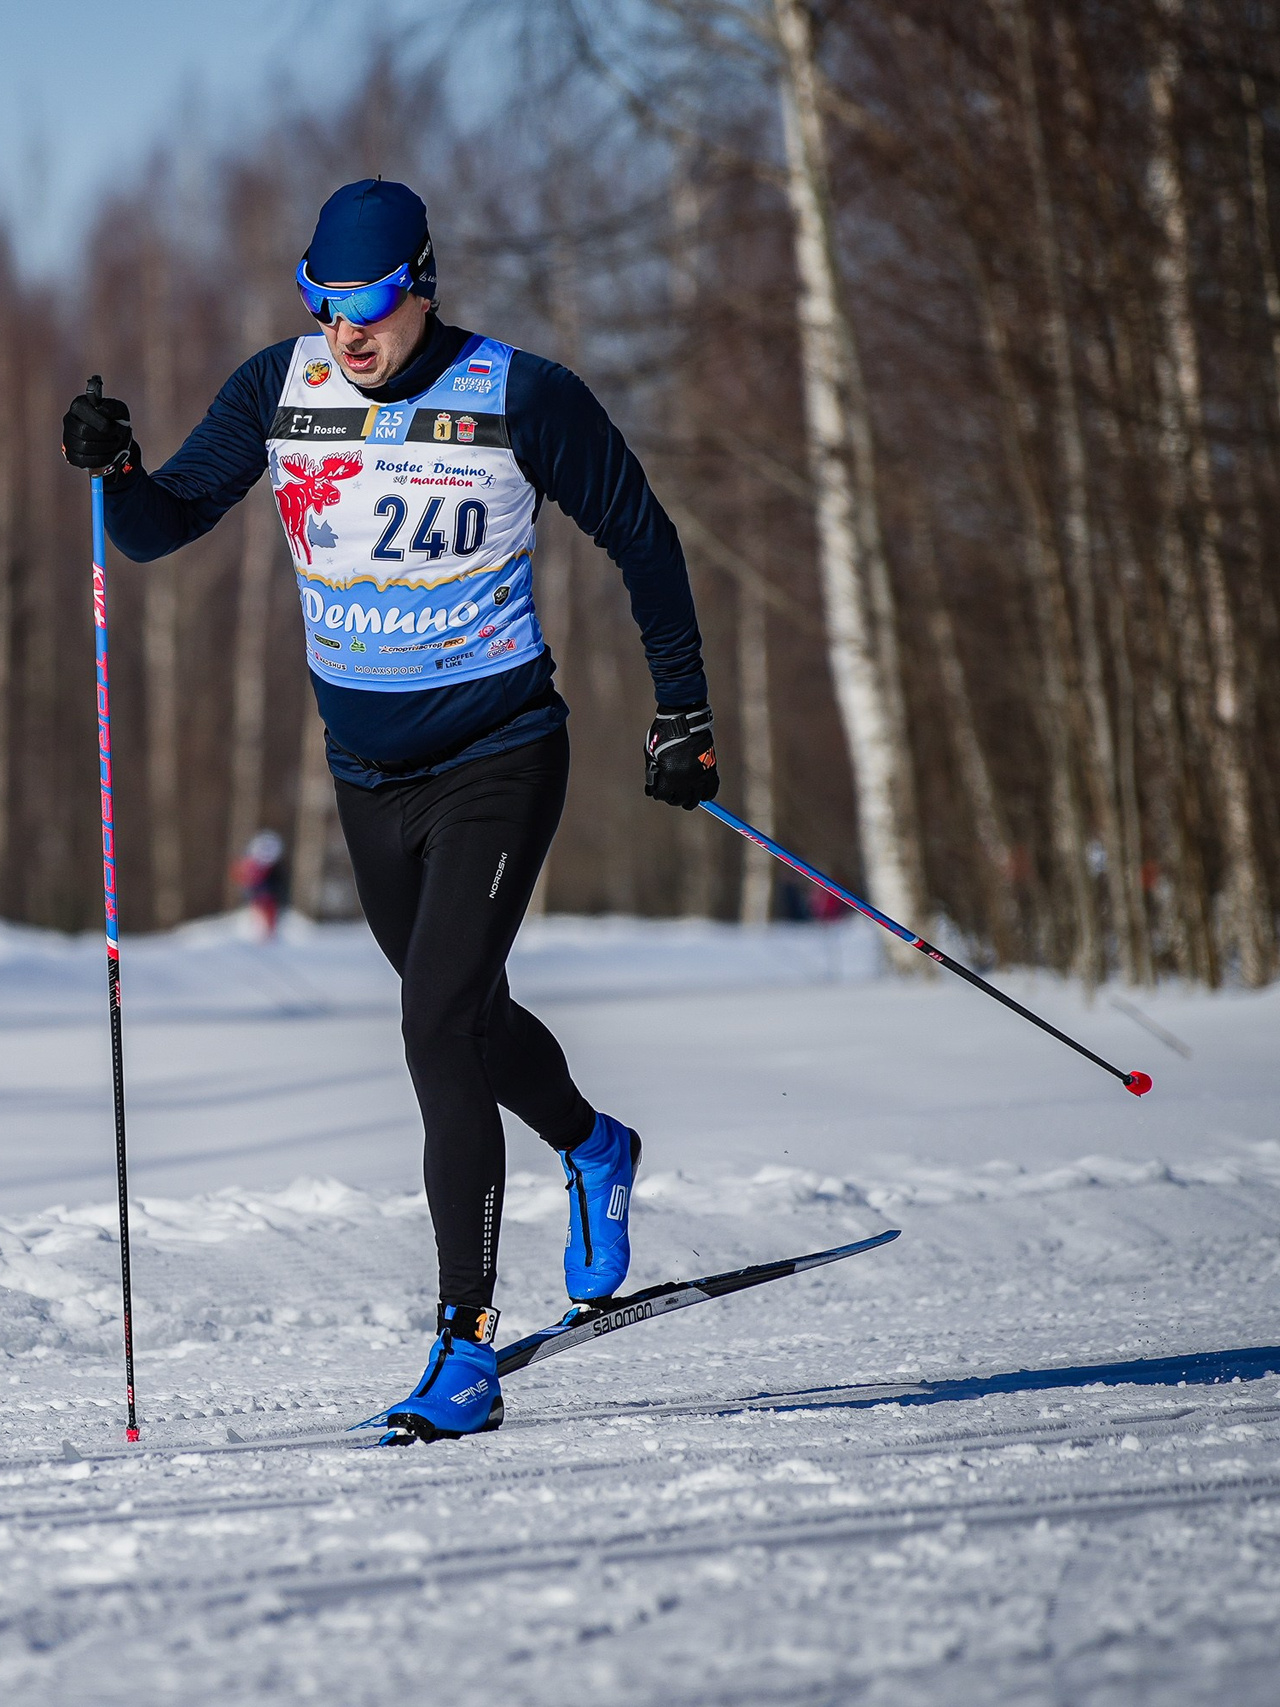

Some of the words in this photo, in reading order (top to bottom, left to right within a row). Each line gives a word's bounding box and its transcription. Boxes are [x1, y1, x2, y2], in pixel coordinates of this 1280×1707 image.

[453, 377, 493, 388] RUSSIA
[379, 410, 404, 427] 25
[313, 425, 347, 435] Rostec
[375, 426, 397, 439] KM
[375, 460, 423, 473] Rostec
[433, 462, 487, 477] Demino
[410, 476, 473, 488] marathon
[371, 493, 489, 562] 240
[445, 652, 474, 663] COFFEE
[446, 660, 463, 669] LIKE
[354, 665, 423, 675] MOAXSPORT
[489, 852, 508, 899] NORDSKI
[592, 1301, 652, 1337] salomon
[484, 1314, 496, 1340] 240
[450, 1378, 489, 1405] SPINE
